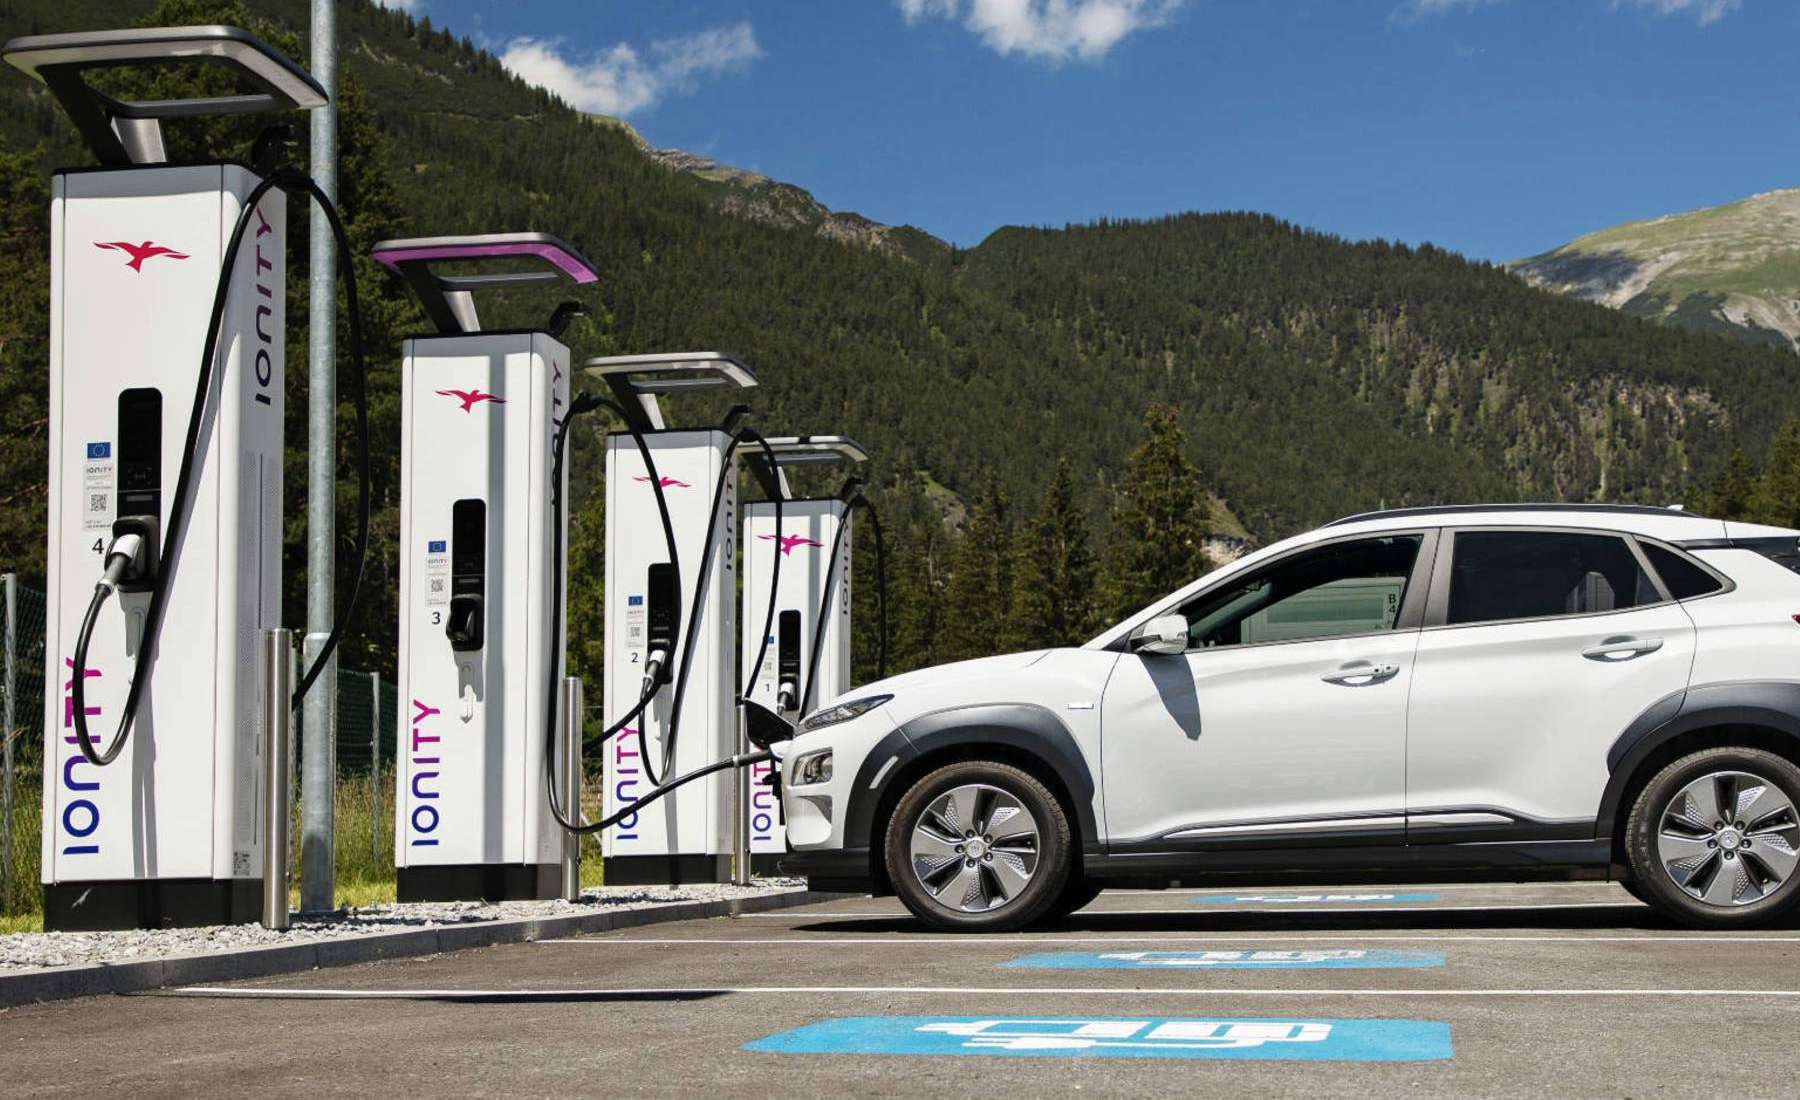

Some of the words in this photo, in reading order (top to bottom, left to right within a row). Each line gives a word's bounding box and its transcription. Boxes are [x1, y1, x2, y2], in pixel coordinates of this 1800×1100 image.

[255, 207, 272, 406] IONITY
[92, 538, 105, 554] 4
[431, 612, 441, 625] 3
[631, 651, 639, 663] 2
[765, 683, 770, 692] 1
[62, 656, 103, 855] IONITY
[411, 699, 441, 846] IONITY
[616, 725, 640, 840] IONITY
[752, 748, 772, 841] IONIT
